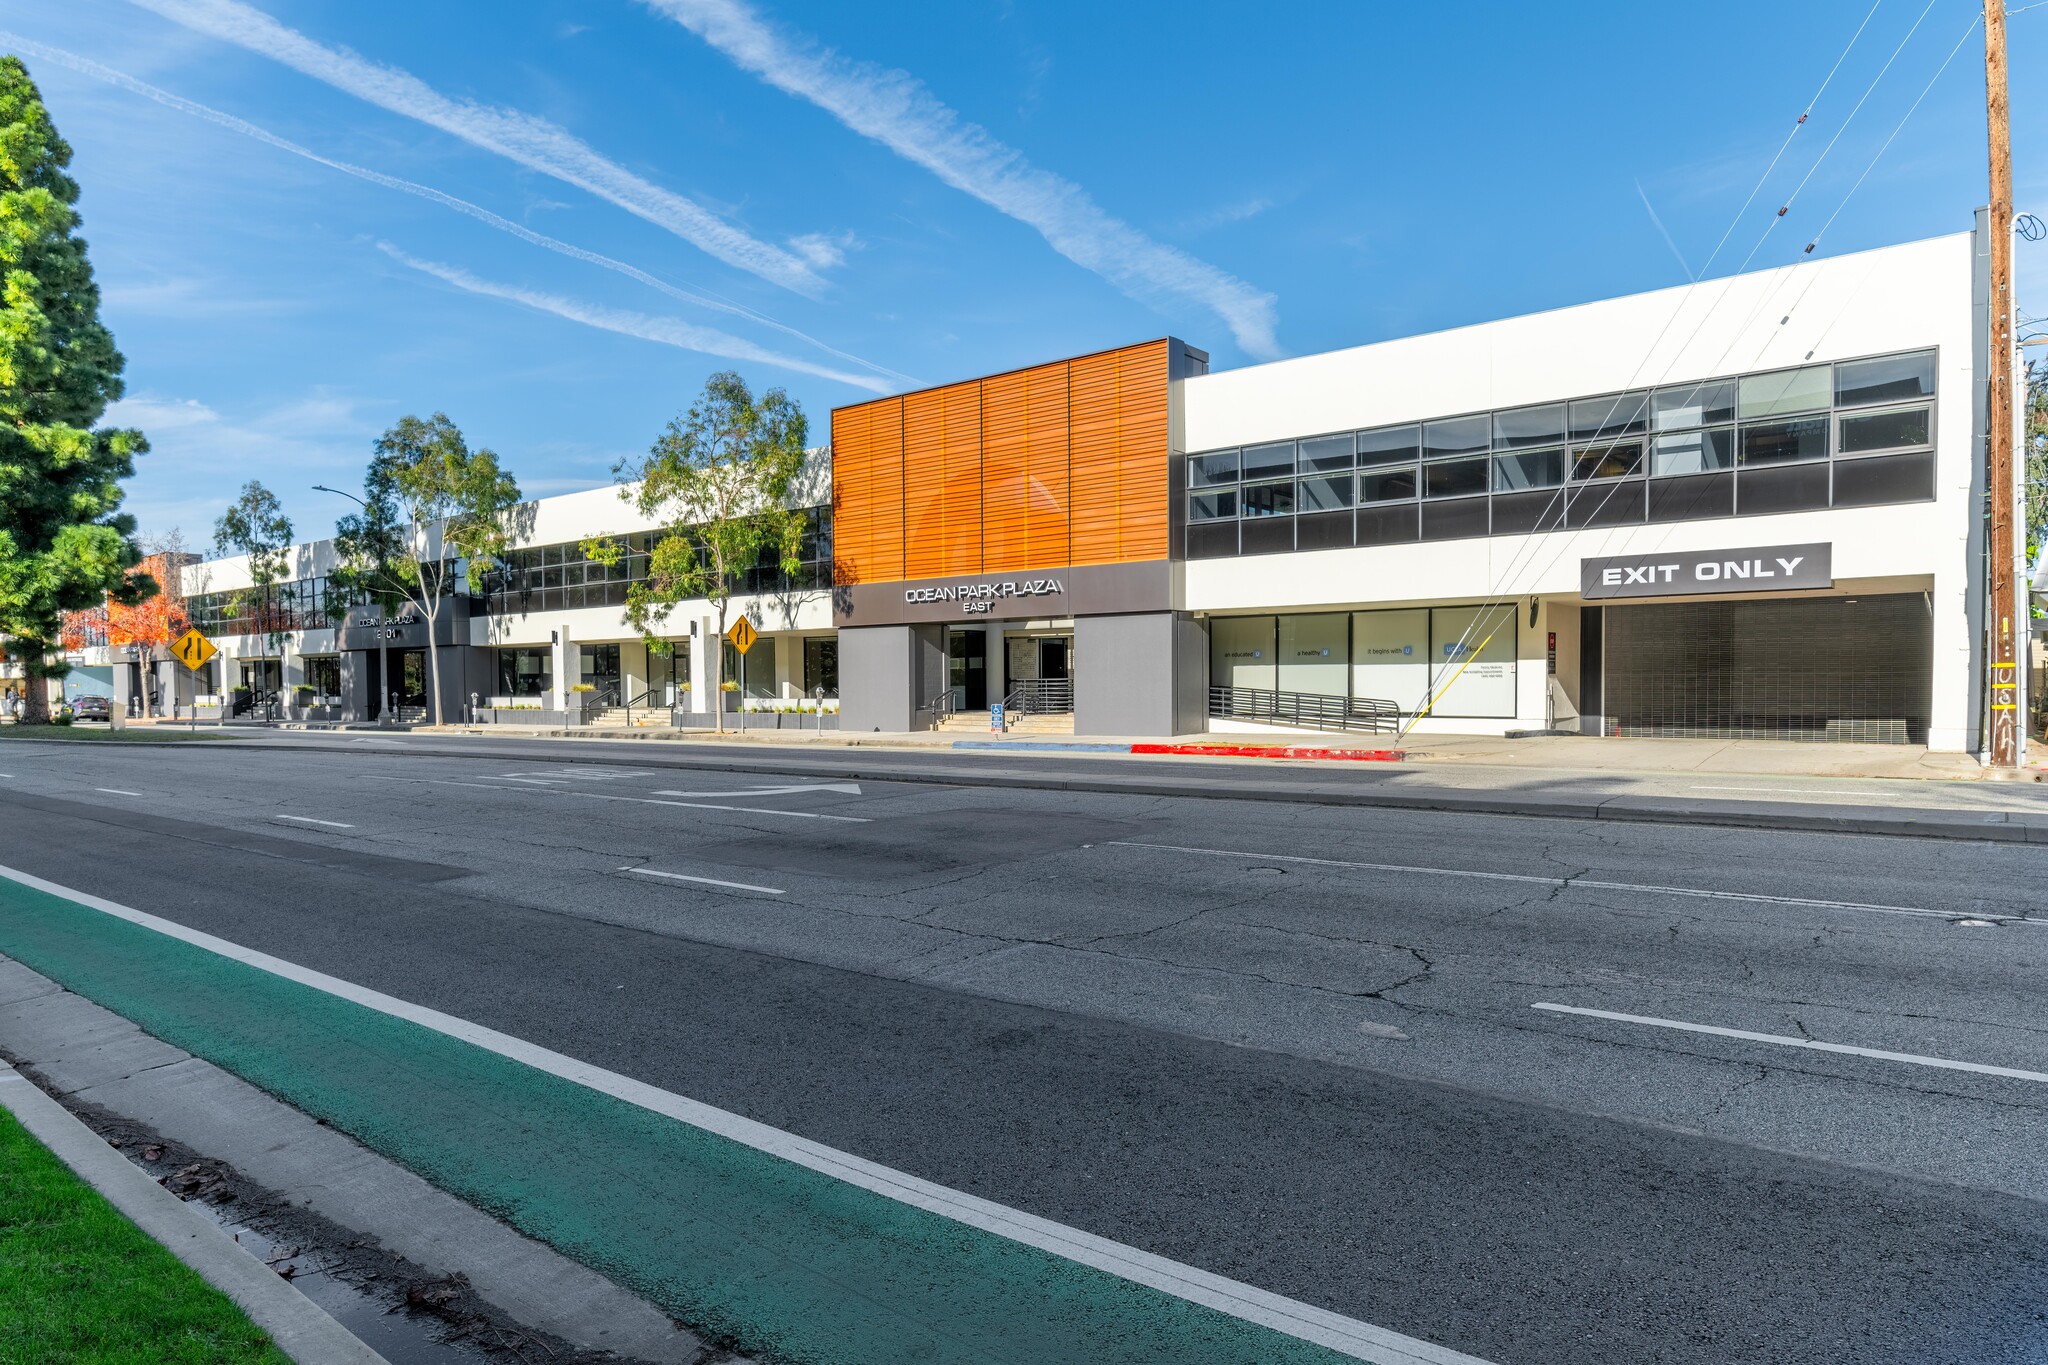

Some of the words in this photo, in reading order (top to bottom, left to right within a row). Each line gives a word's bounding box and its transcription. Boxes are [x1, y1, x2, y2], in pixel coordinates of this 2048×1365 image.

[1602, 564, 1680, 586] EXIT
[1695, 556, 1804, 581] ONLY
[905, 588, 956, 603] OCEAN
[958, 584, 1000, 599] PARK
[1003, 579, 1060, 596] PLAZA
[963, 602, 992, 612] EAST
[376, 629, 396, 639] 201
[1301, 649, 1320, 657] healthy
[1372, 647, 1390, 656] begins
